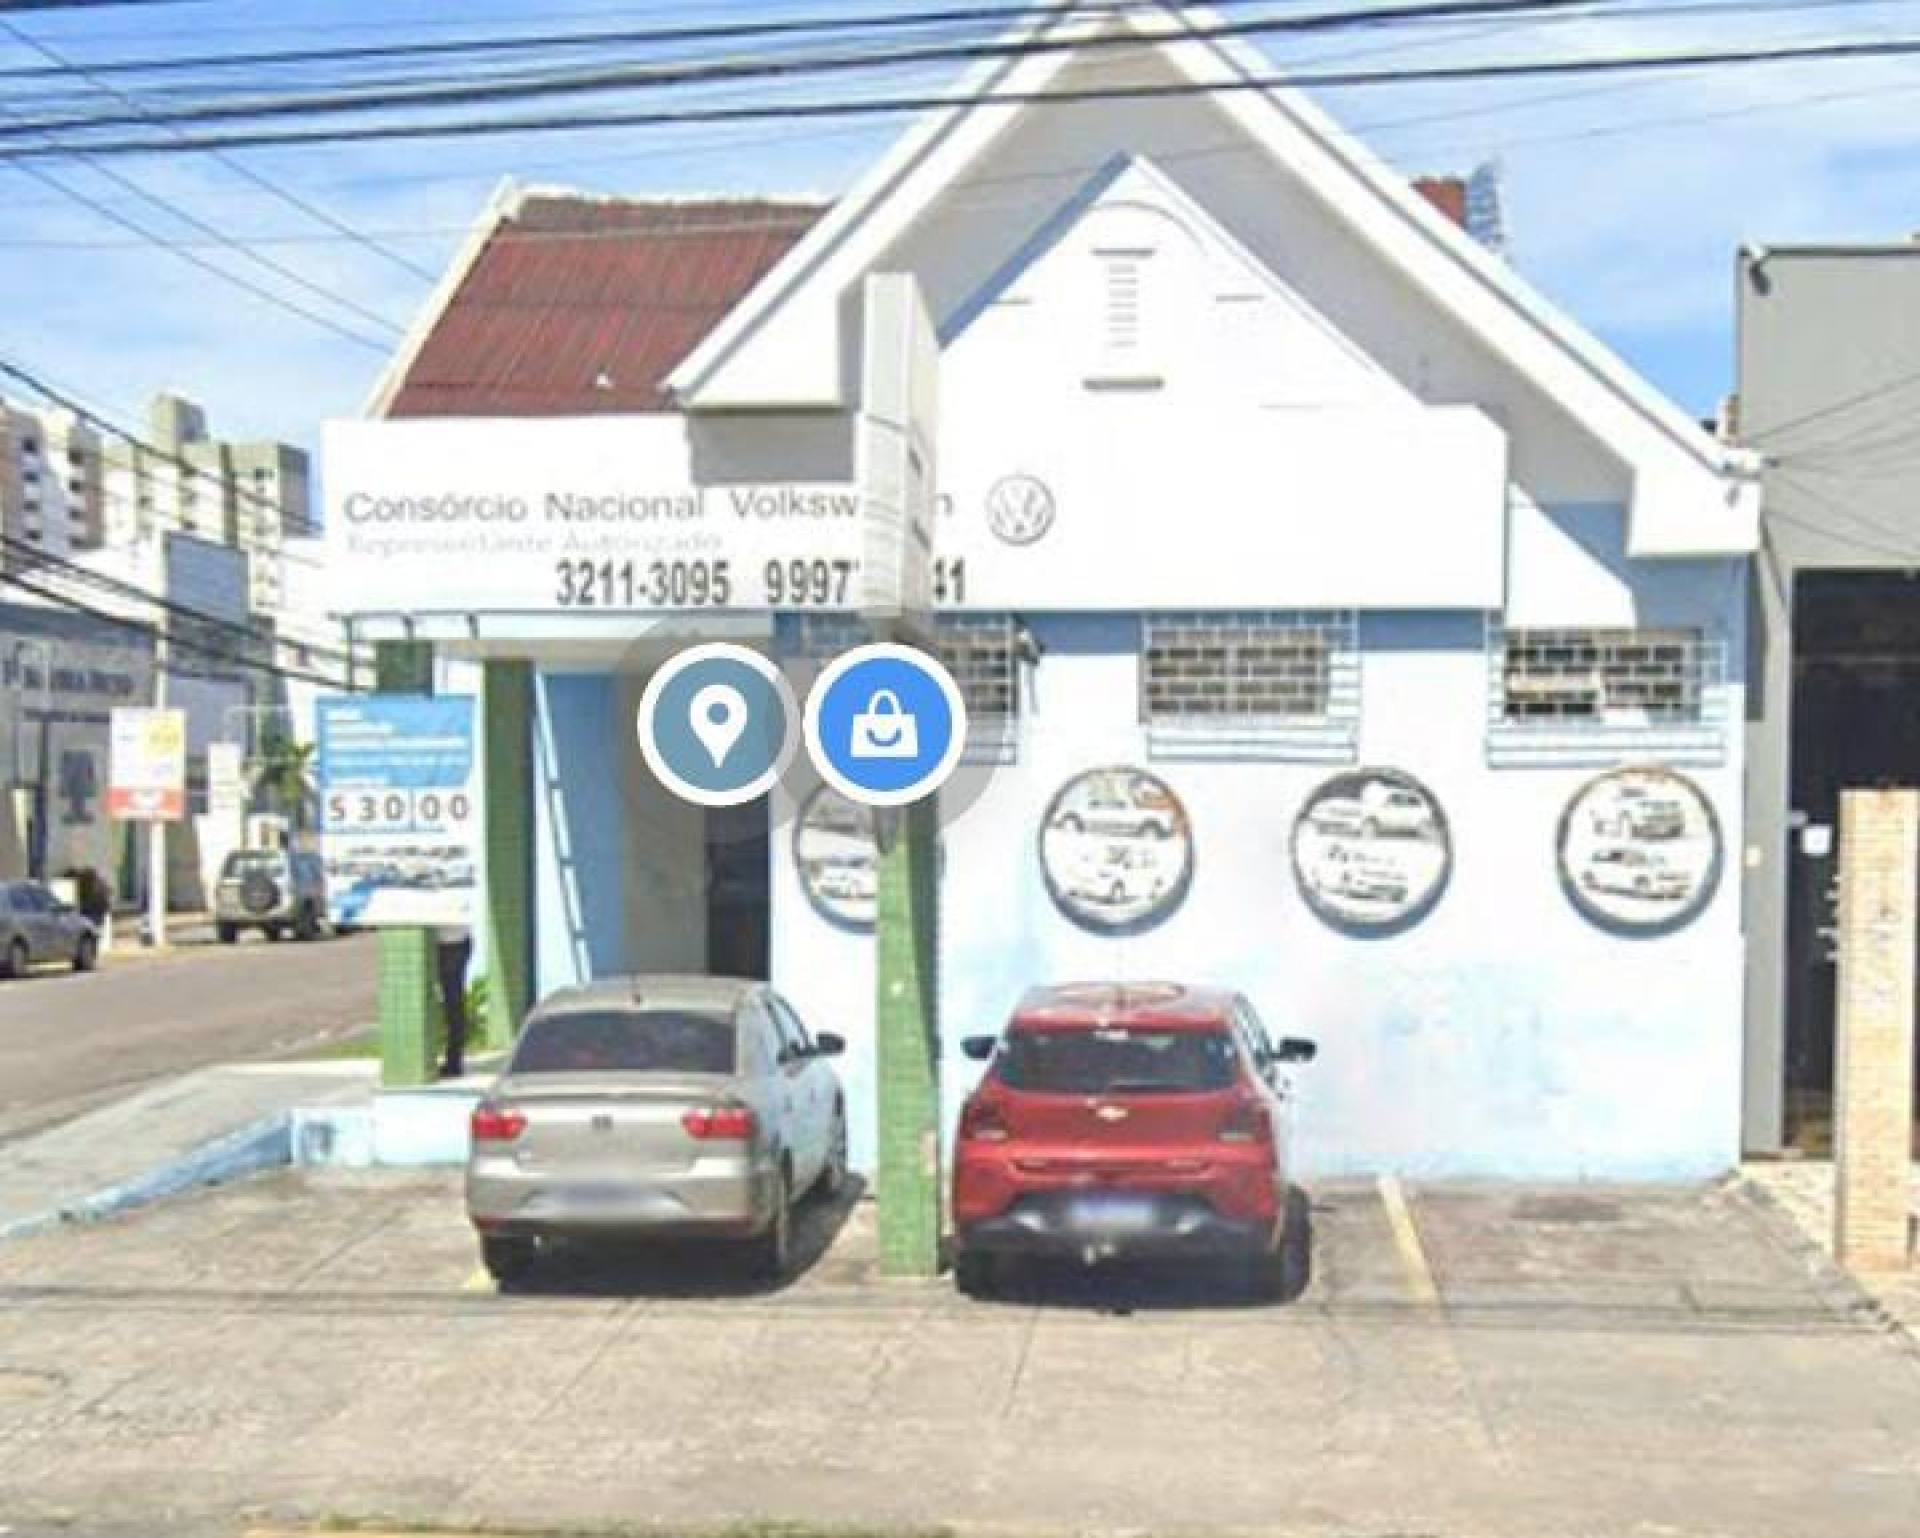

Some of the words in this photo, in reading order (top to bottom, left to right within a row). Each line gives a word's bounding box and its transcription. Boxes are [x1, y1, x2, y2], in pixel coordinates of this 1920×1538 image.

[345, 491, 528, 523] Consórcio
[544, 491, 705, 521] Nacional
[729, 488, 954, 518] Volkswn
[556, 559, 730, 605] 3211-3095
